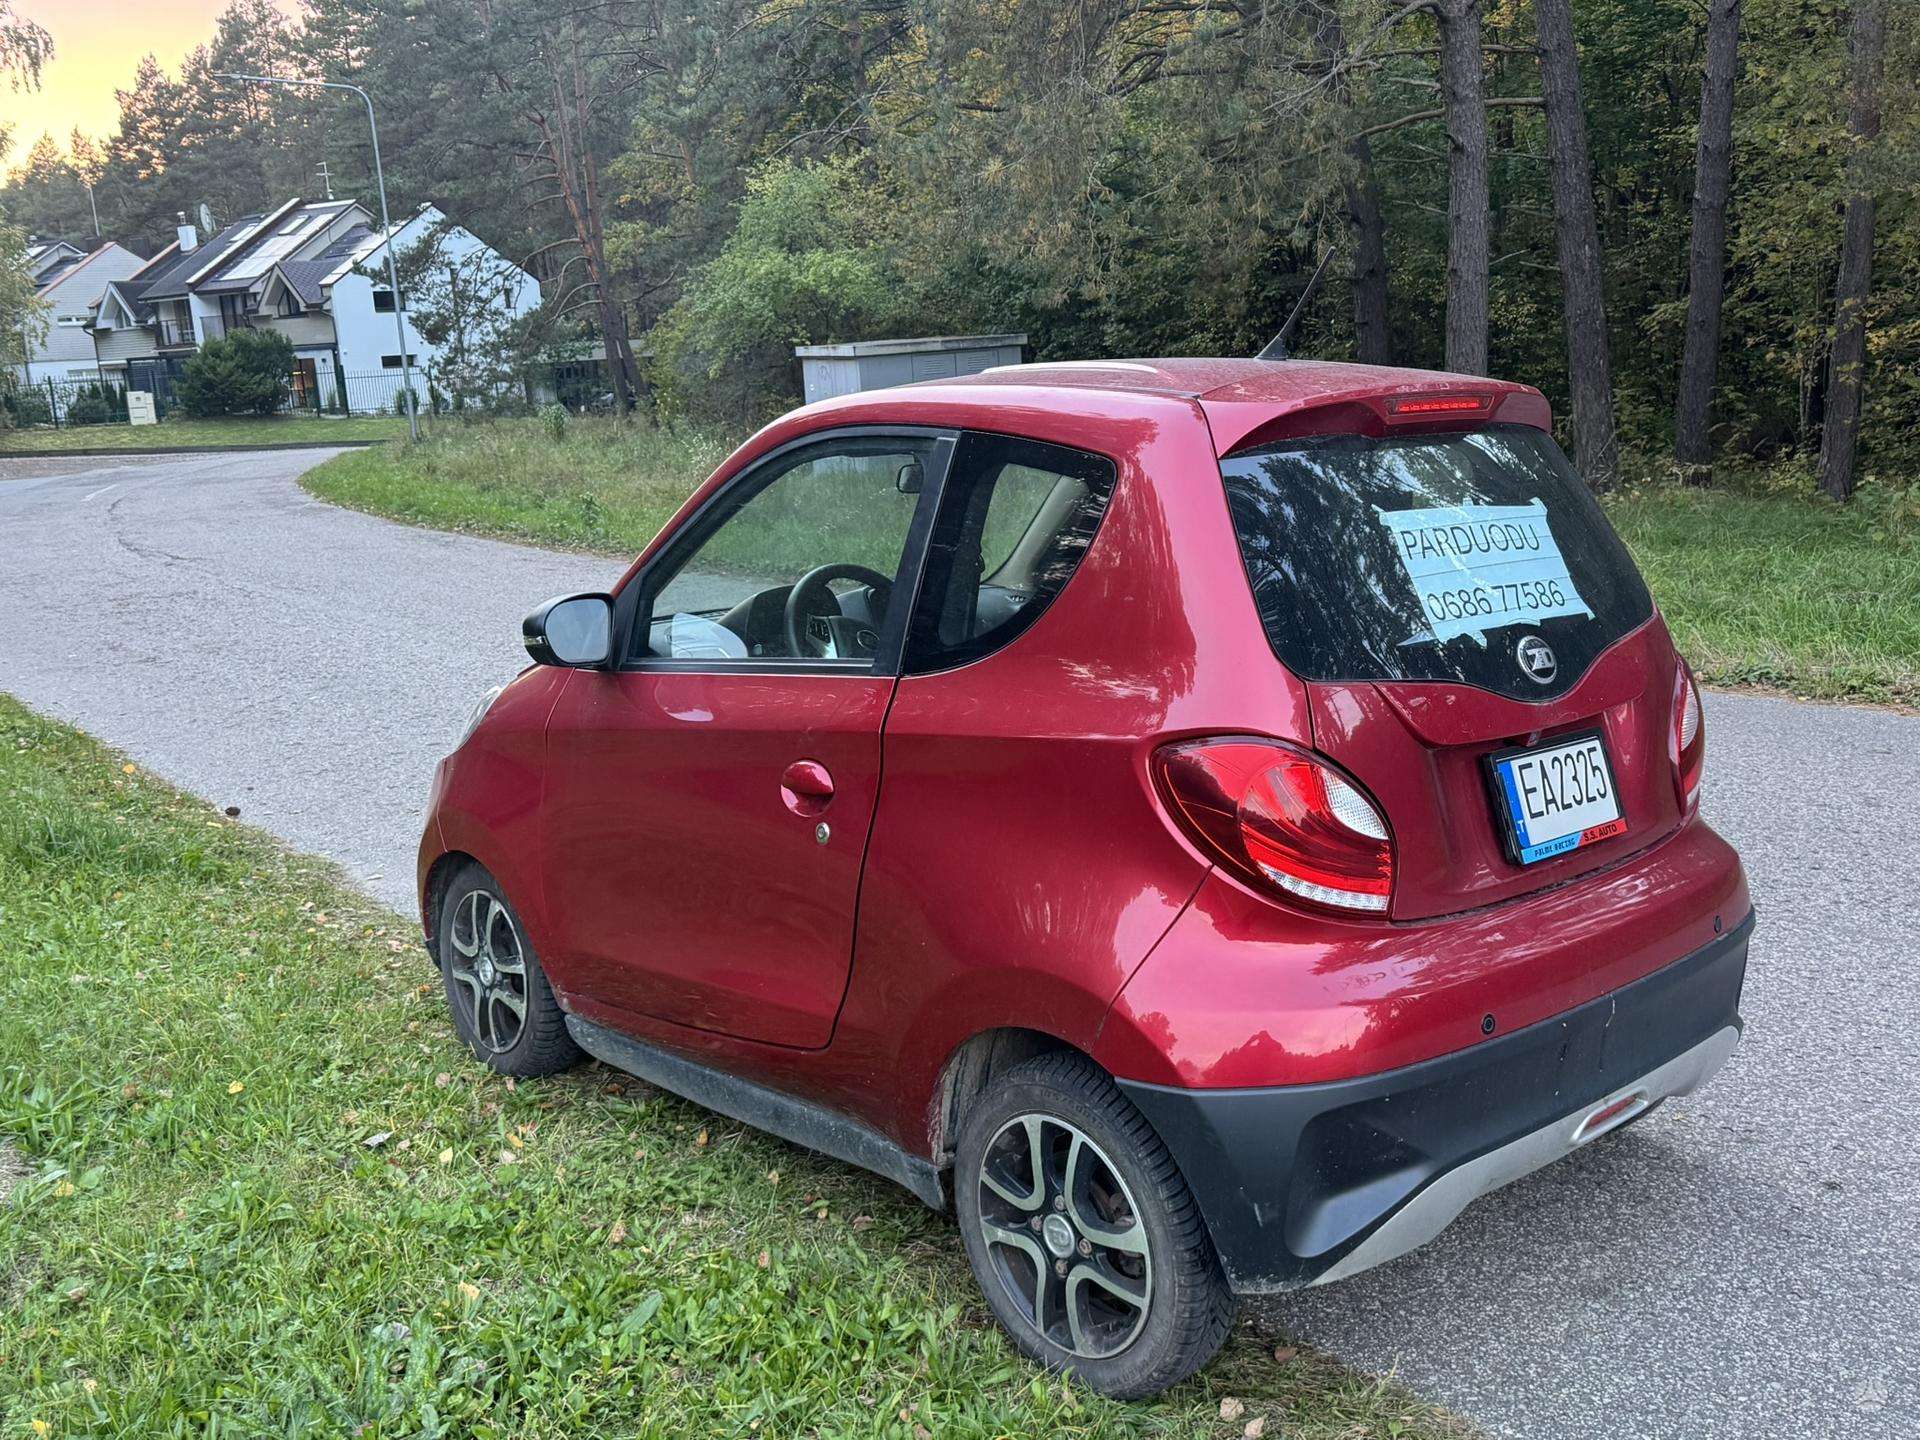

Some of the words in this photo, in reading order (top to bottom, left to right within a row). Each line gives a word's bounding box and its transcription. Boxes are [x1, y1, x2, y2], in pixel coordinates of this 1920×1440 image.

[1401, 524, 1540, 560] PARDUODU
[1518, 747, 1607, 819] EA2325
[1599, 823, 1617, 837] AUTO
